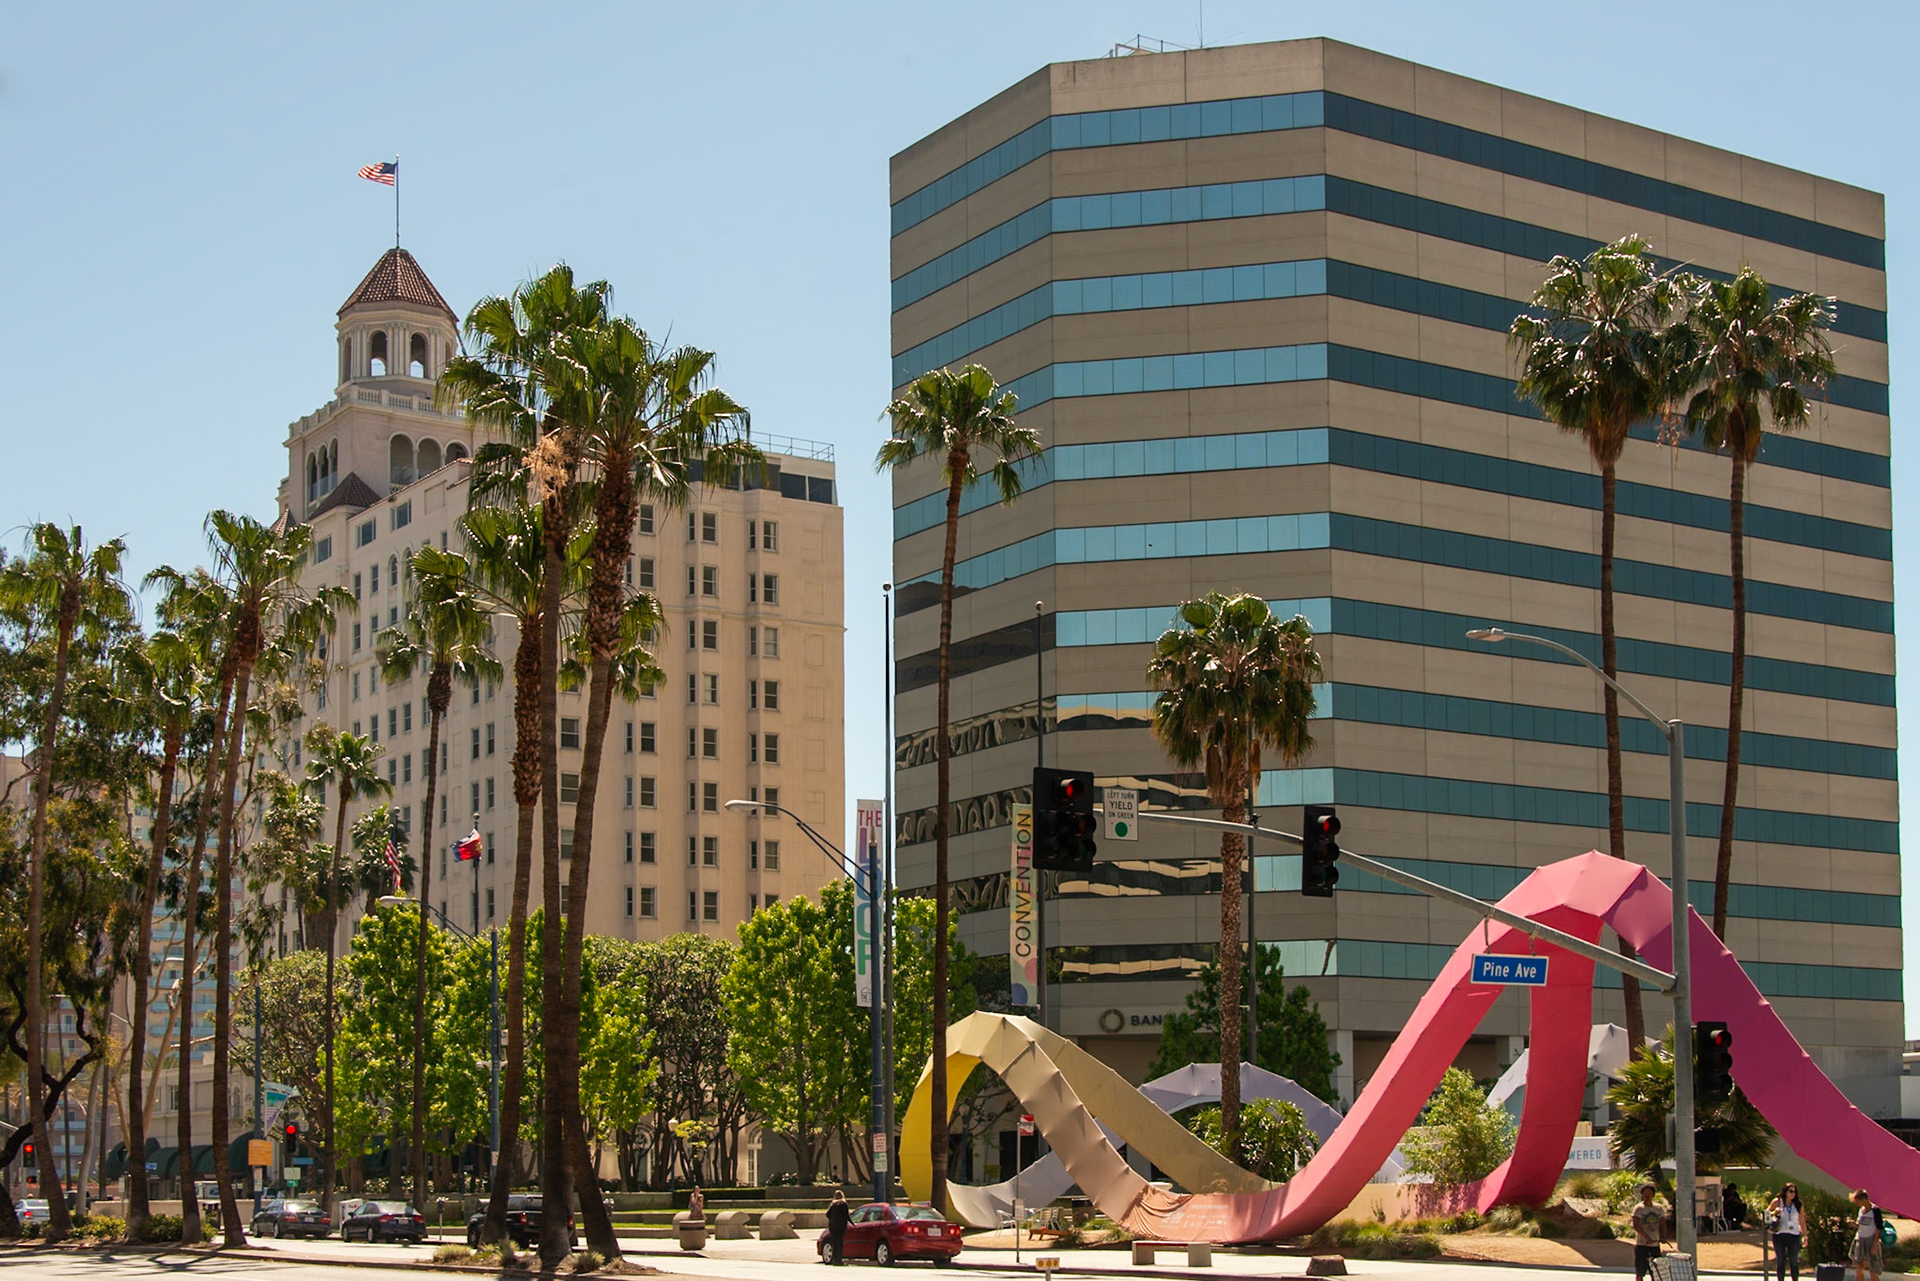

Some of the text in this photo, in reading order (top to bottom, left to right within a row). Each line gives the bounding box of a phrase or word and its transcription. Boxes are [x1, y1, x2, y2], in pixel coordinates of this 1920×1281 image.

[1107, 790, 1119, 799] LEFT
[1110, 801, 1133, 810] YIELD
[858, 810, 882, 827] THE
[1015, 813, 1031, 957] CONVENTION
[1483, 962, 1537, 978] Pine Ave
[1130, 1015, 1162, 1026] BAN
[1569, 1149, 1602, 1160] WERED
